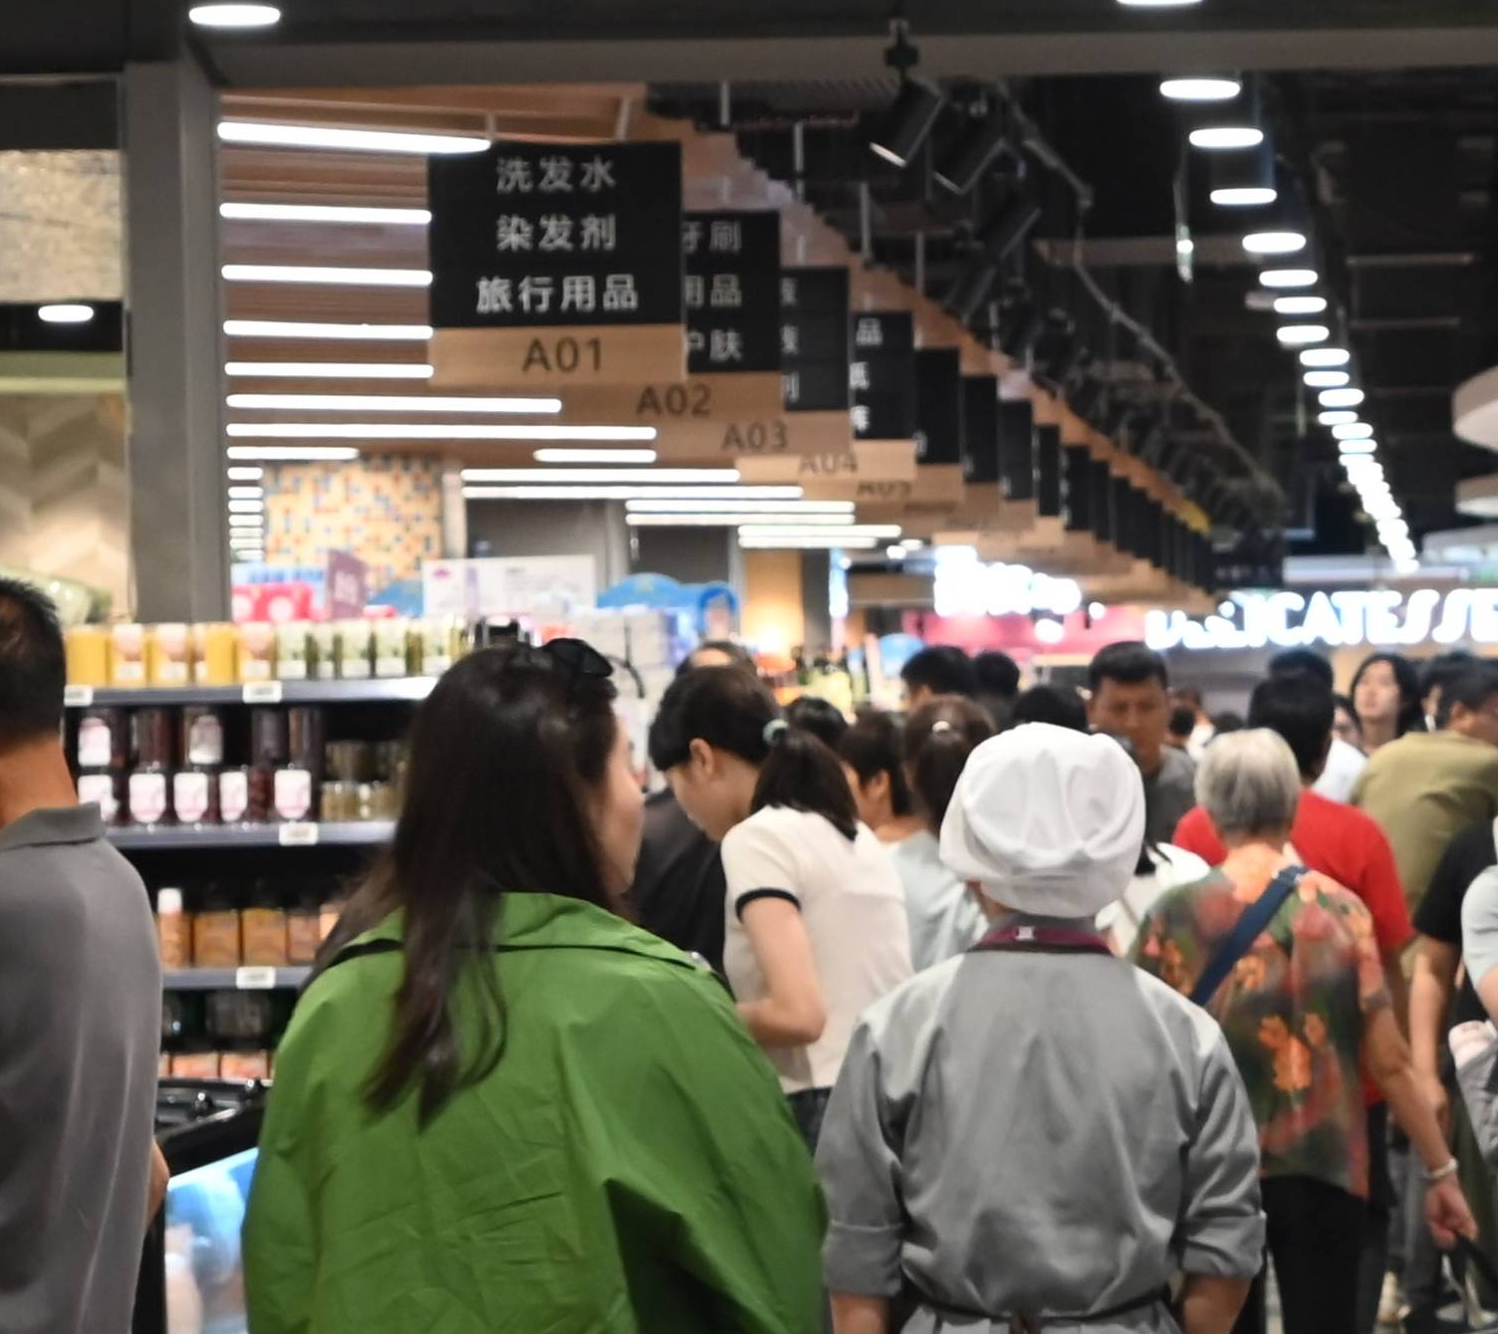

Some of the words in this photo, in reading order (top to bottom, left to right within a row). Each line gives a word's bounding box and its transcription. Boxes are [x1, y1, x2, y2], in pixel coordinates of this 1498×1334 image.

[496, 157, 616, 194] 洗发水
[496, 214, 616, 251] 染发剂
[476, 273, 638, 314] 旅行用品
[522, 337, 601, 372] A01
[636, 384, 711, 417] A02
[721, 420, 789, 452] A03
